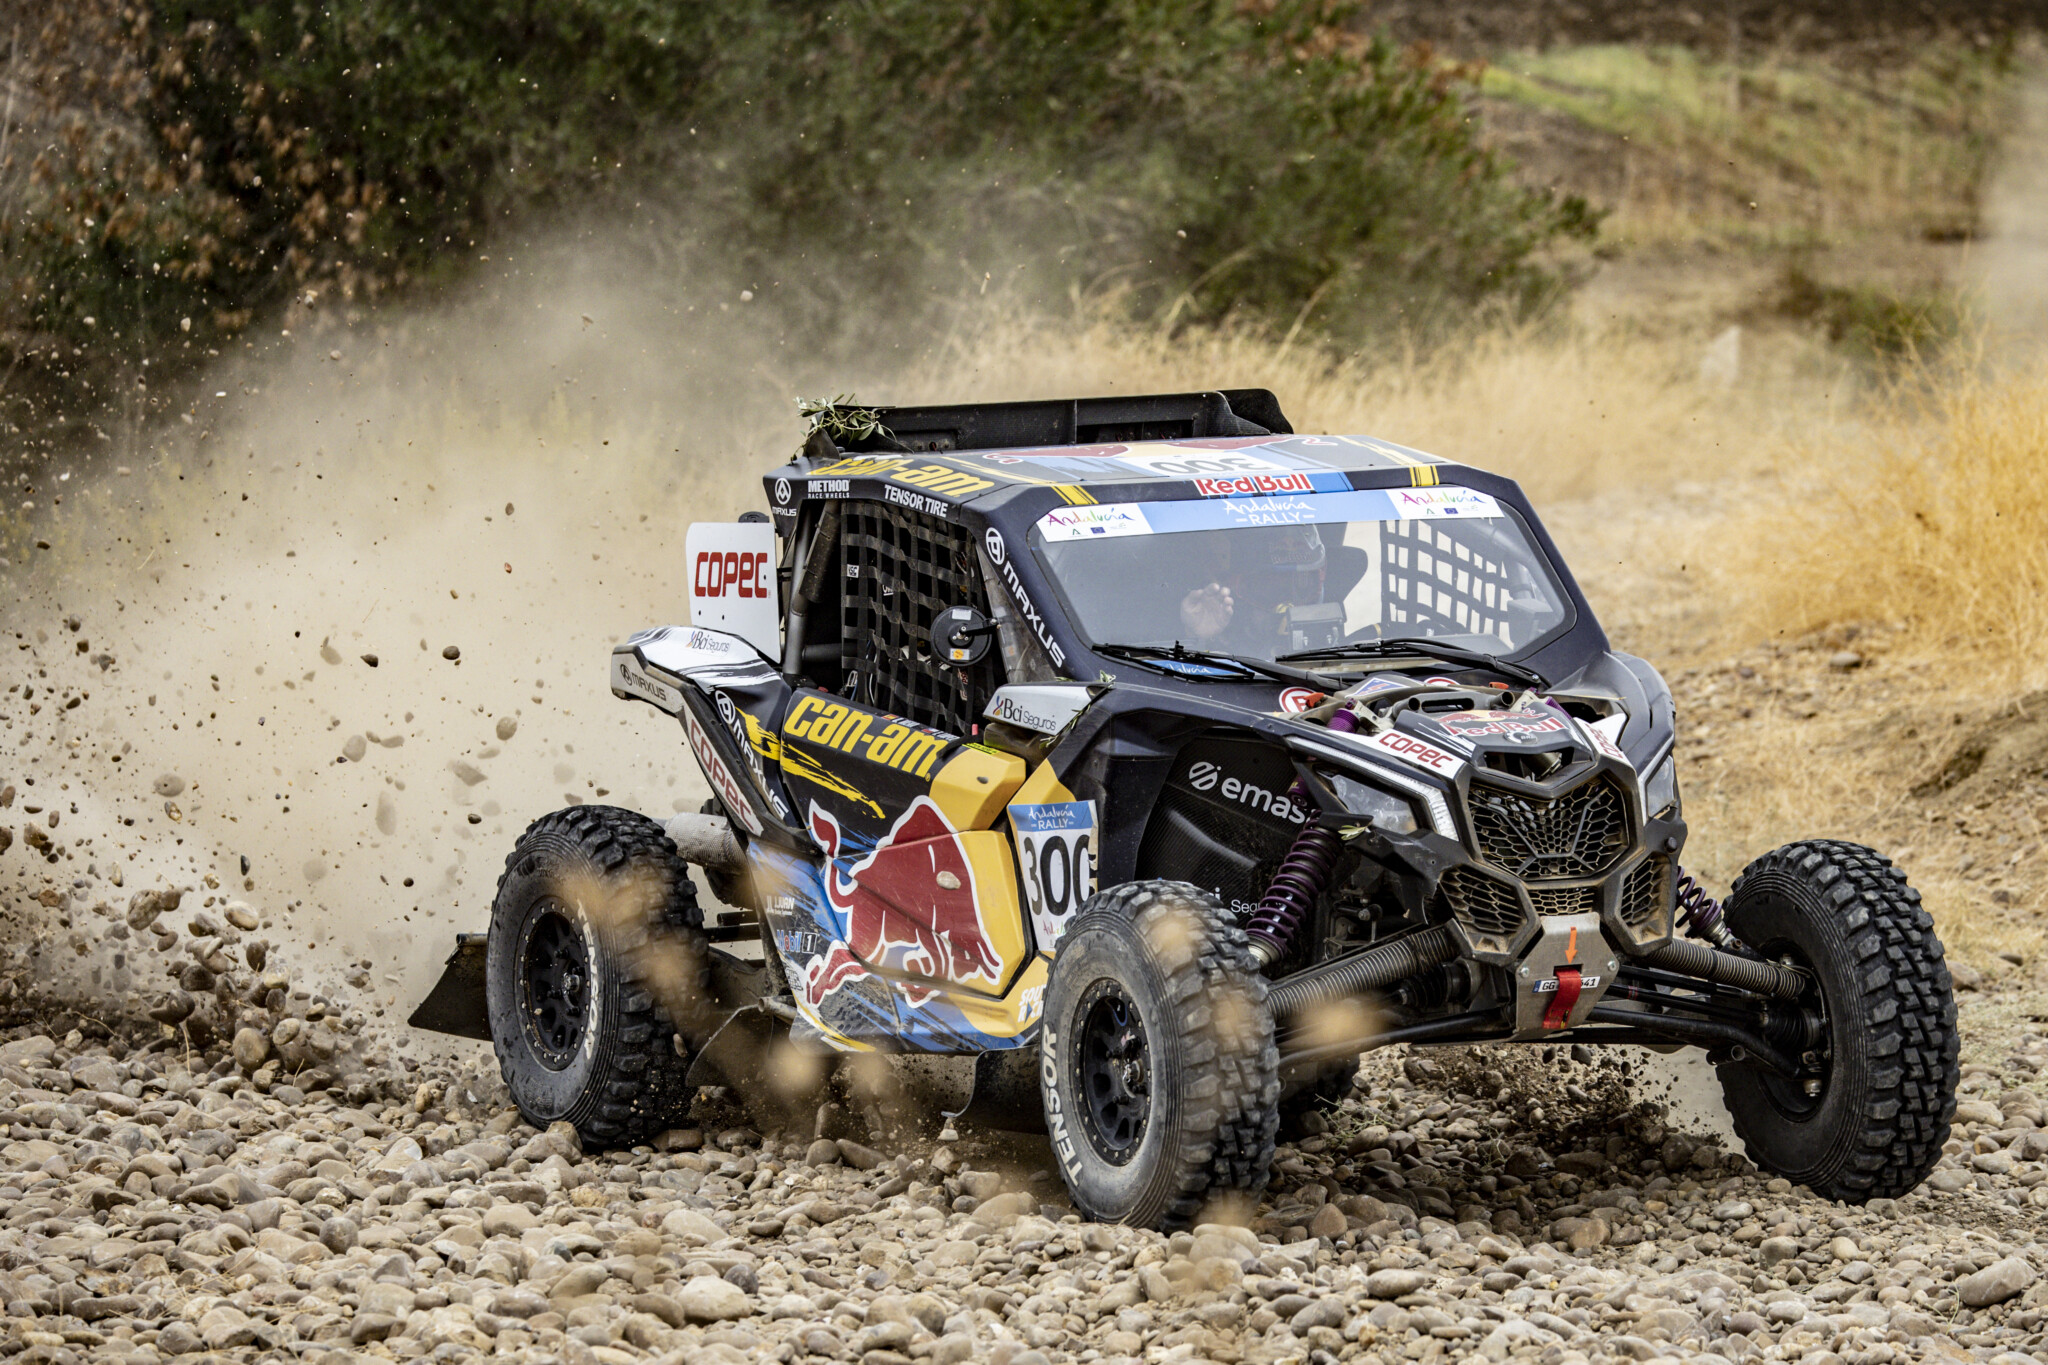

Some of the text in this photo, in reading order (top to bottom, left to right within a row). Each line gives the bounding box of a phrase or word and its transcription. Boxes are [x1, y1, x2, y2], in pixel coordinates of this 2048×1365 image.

[807, 480, 850, 493] METHOD
[1196, 474, 1313, 495] Red Bull
[771, 506, 798, 517] MAXUS
[884, 484, 949, 518] TENSOR TIRE
[1248, 512, 1301, 525] RALLY
[1003, 560, 1066, 669] MAXUS
[631, 670, 667, 701] MAXUS
[1003, 698, 1057, 732] Bci Seguros
[1443, 717, 1567, 737] Red Bull
[733, 718, 789, 821] MAXUS
[1037, 818, 1069, 831] RALLY
[776, 929, 802, 953] Mobil
[1043, 1023, 1083, 1187] TENSOR
